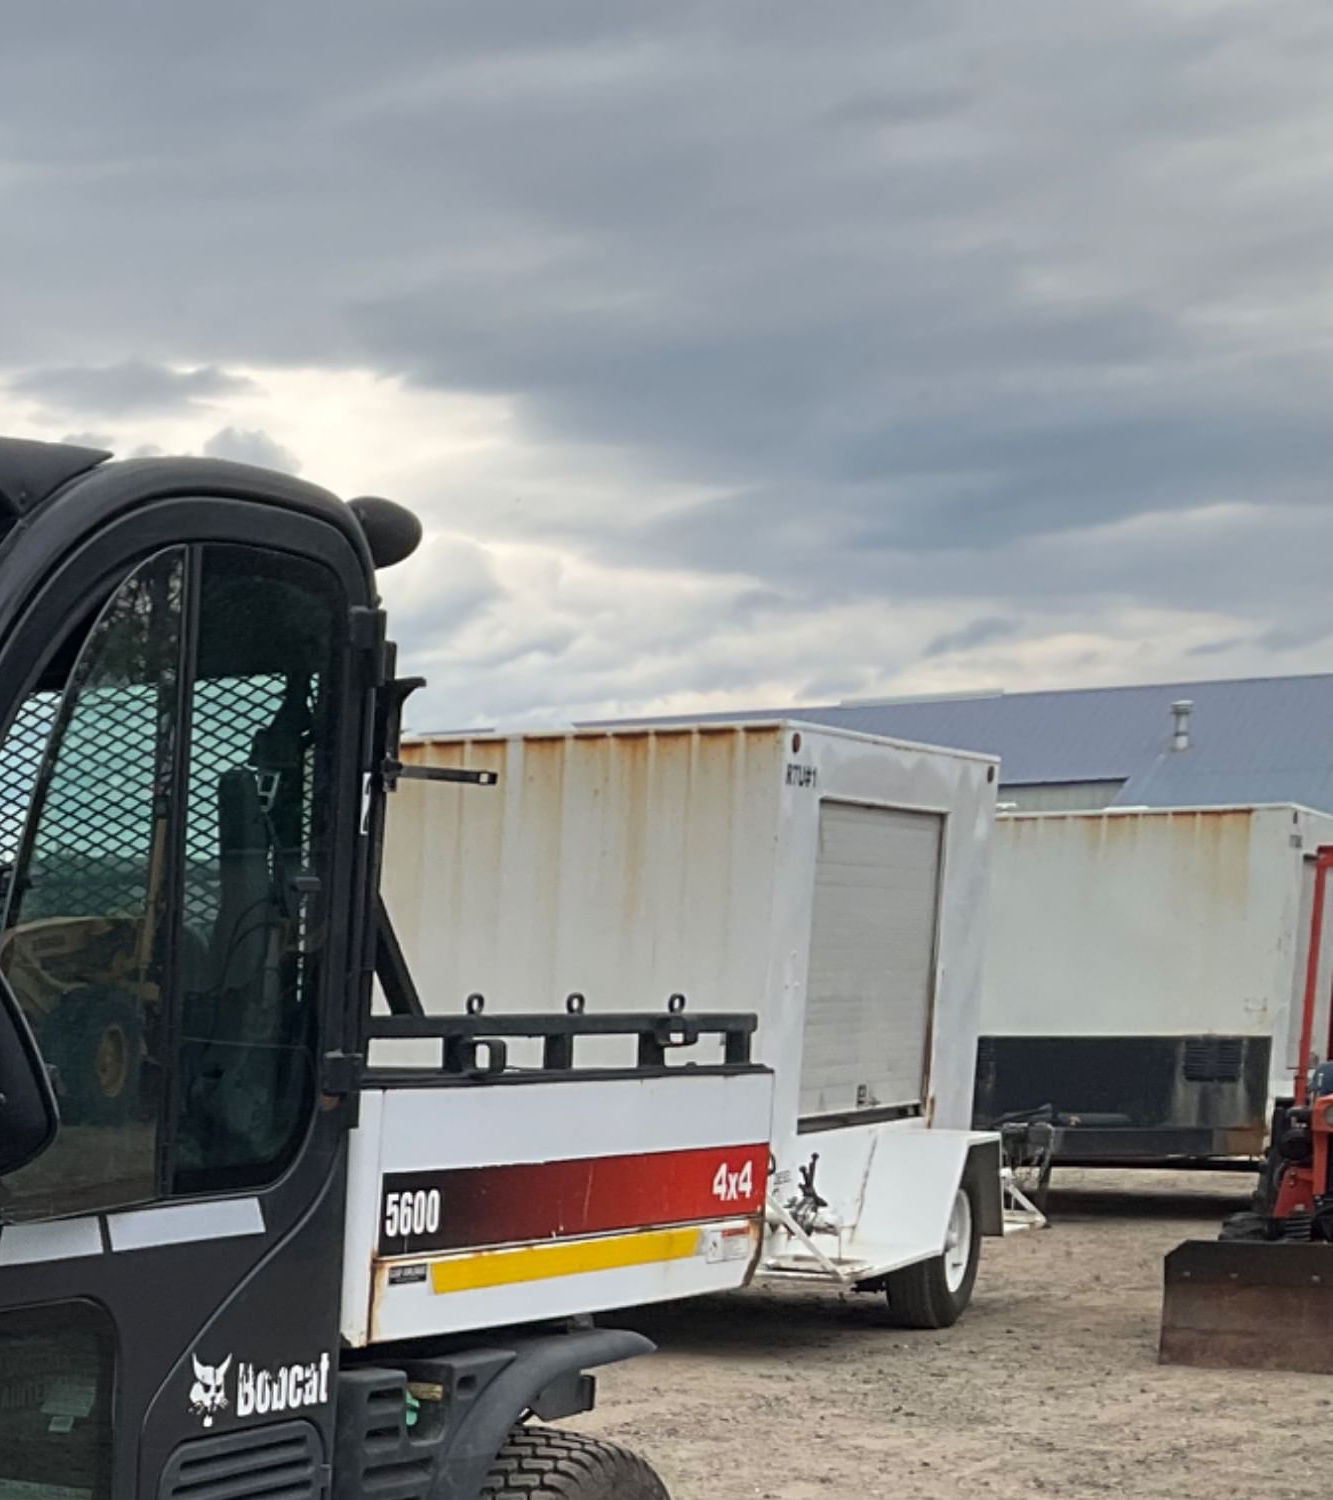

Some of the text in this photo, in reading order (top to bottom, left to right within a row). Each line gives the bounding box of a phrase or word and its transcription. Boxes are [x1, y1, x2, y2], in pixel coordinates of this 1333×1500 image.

[712, 1159, 753, 1201] 4x4
[385, 1187, 441, 1238] 5600
[236, 1351, 330, 1417] Bobcat
